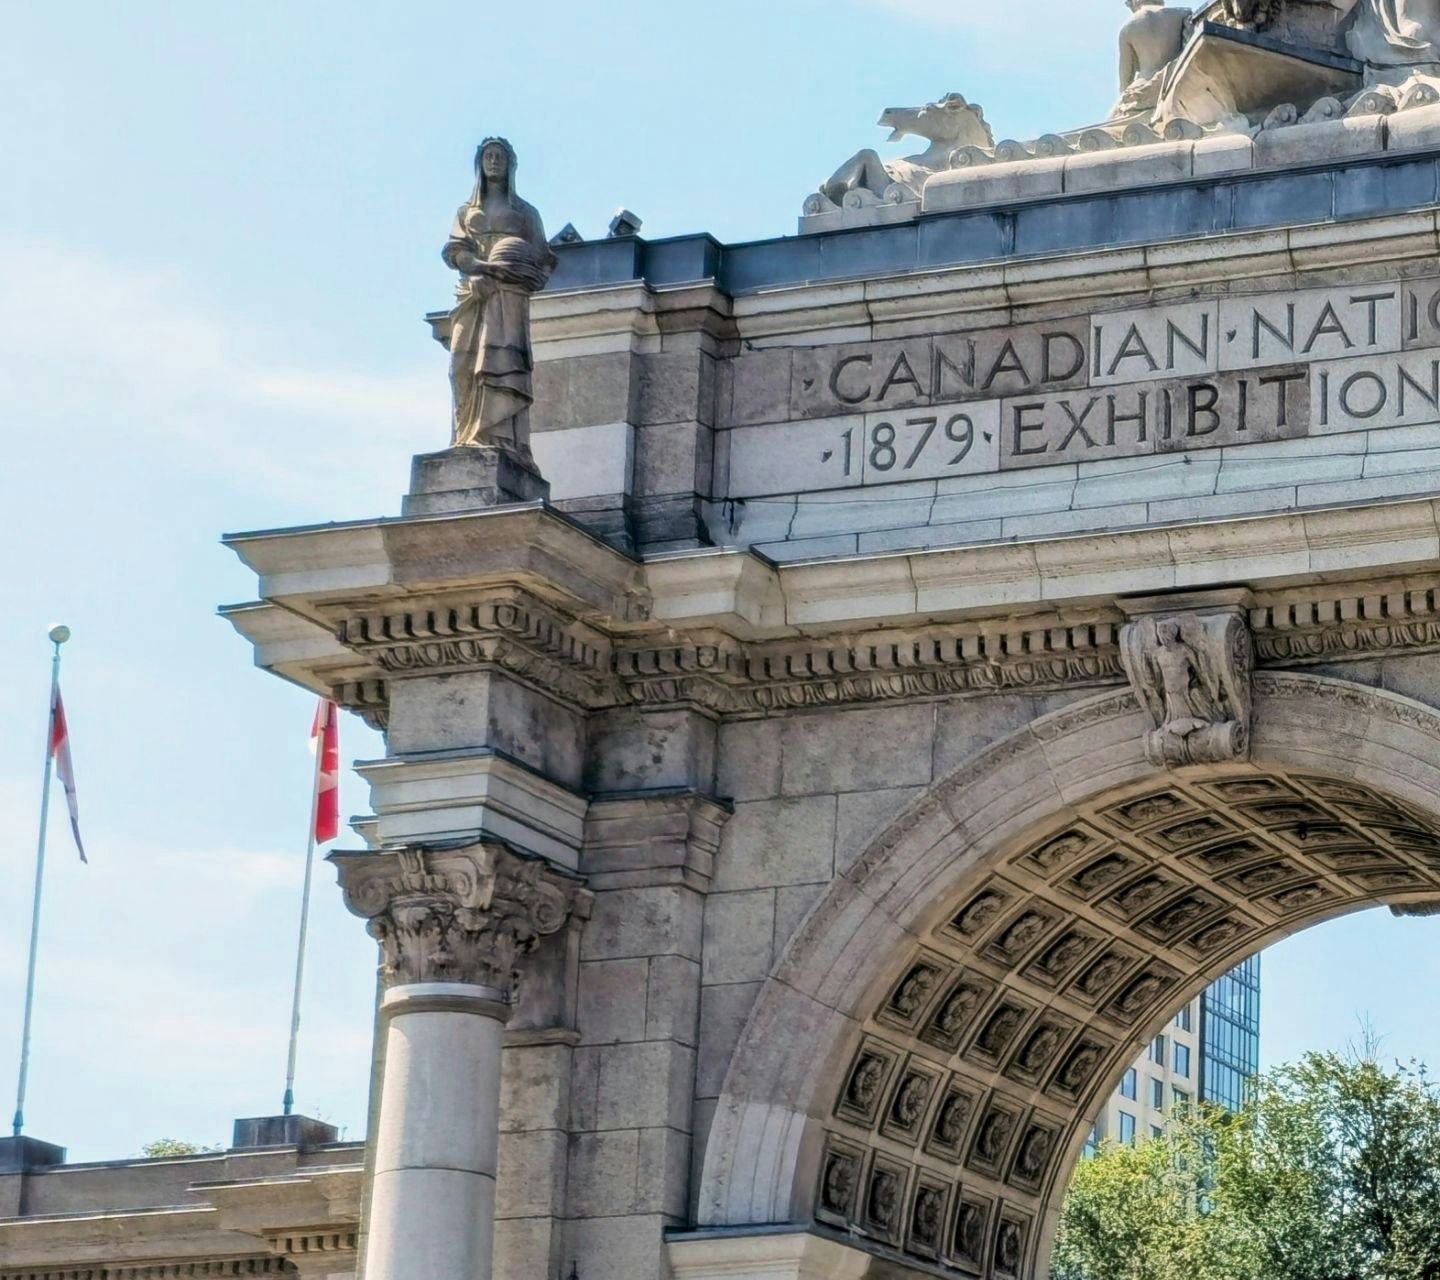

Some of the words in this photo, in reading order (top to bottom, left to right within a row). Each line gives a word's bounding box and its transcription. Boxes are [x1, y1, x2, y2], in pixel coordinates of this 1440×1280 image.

[828, 313, 1210, 404] CANADIAN
[838, 412, 975, 477] 1879
[1011, 359, 1440, 456] EXHIBITION
